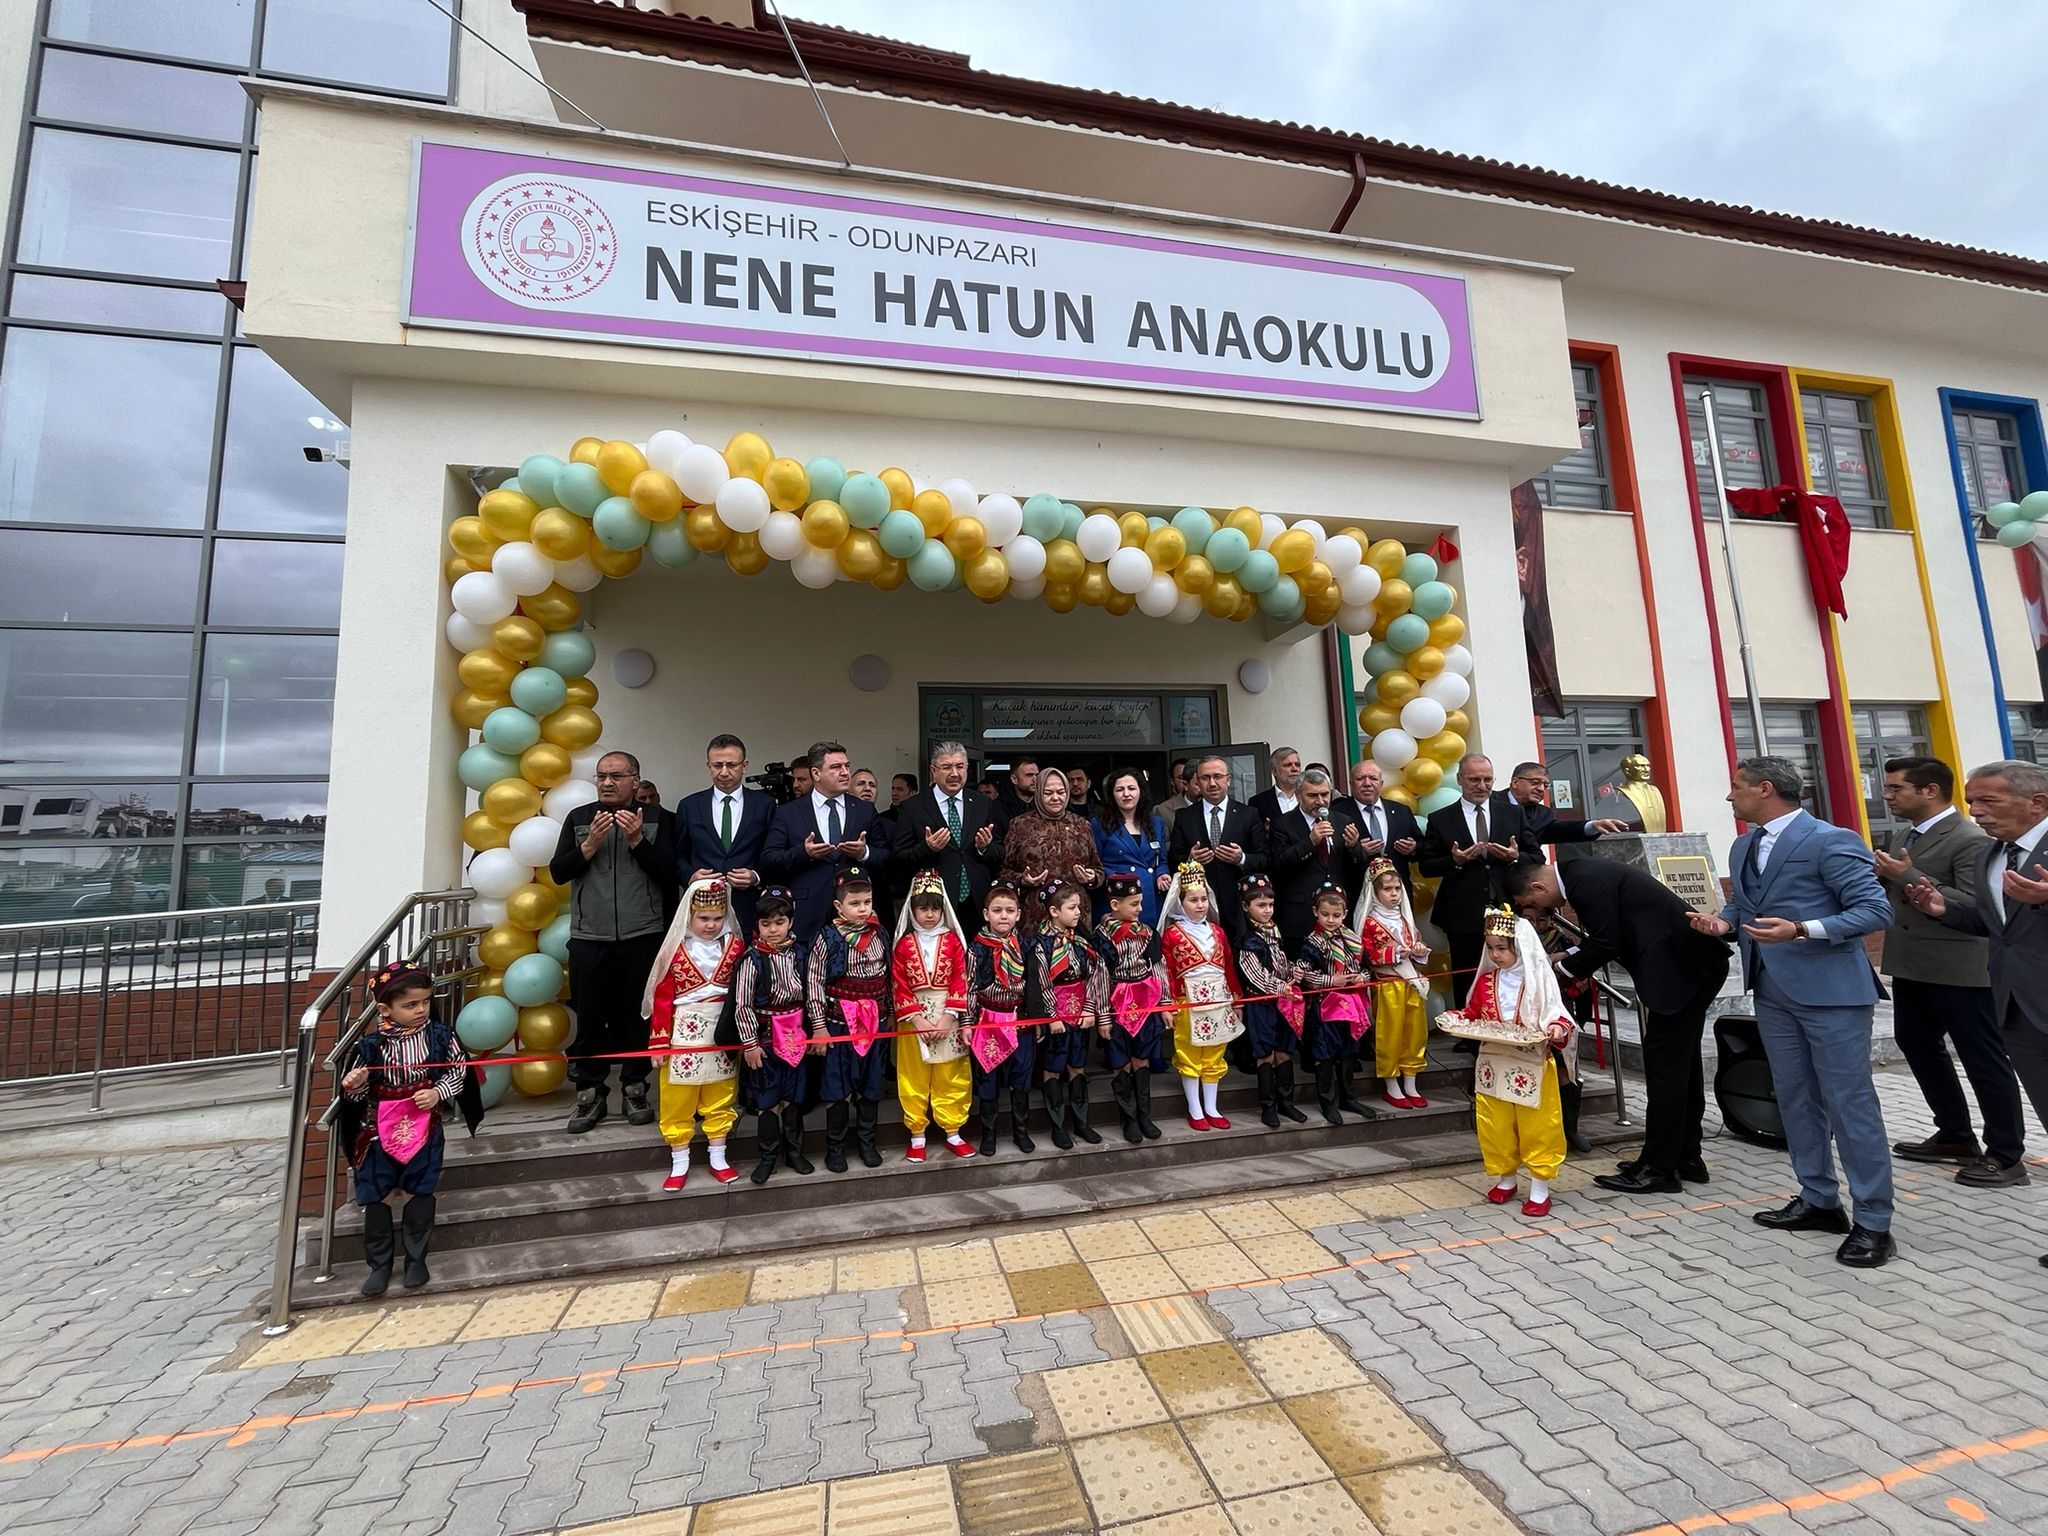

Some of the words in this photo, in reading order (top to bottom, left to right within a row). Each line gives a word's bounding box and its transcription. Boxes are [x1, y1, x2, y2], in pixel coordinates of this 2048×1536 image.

[502, 202, 543, 246] CUMHURİYETİ
[572, 215, 592, 243] EĞİTİM
[647, 200, 819, 242] ESKİŞEHİR
[848, 225, 1037, 267] ODUNPAZARI
[507, 248, 537, 276] TÜRKİYE
[557, 245, 592, 279] BAKANLIĞI
[646, 245, 836, 319] NENE
[873, 271, 1094, 344] HATUN
[1126, 299, 1435, 380] ANAOKULU
[1665, 873, 1678, 882] NE
[1678, 872, 1705, 882] MUTLU
[1672, 883, 1706, 893] TÜRKÜM
